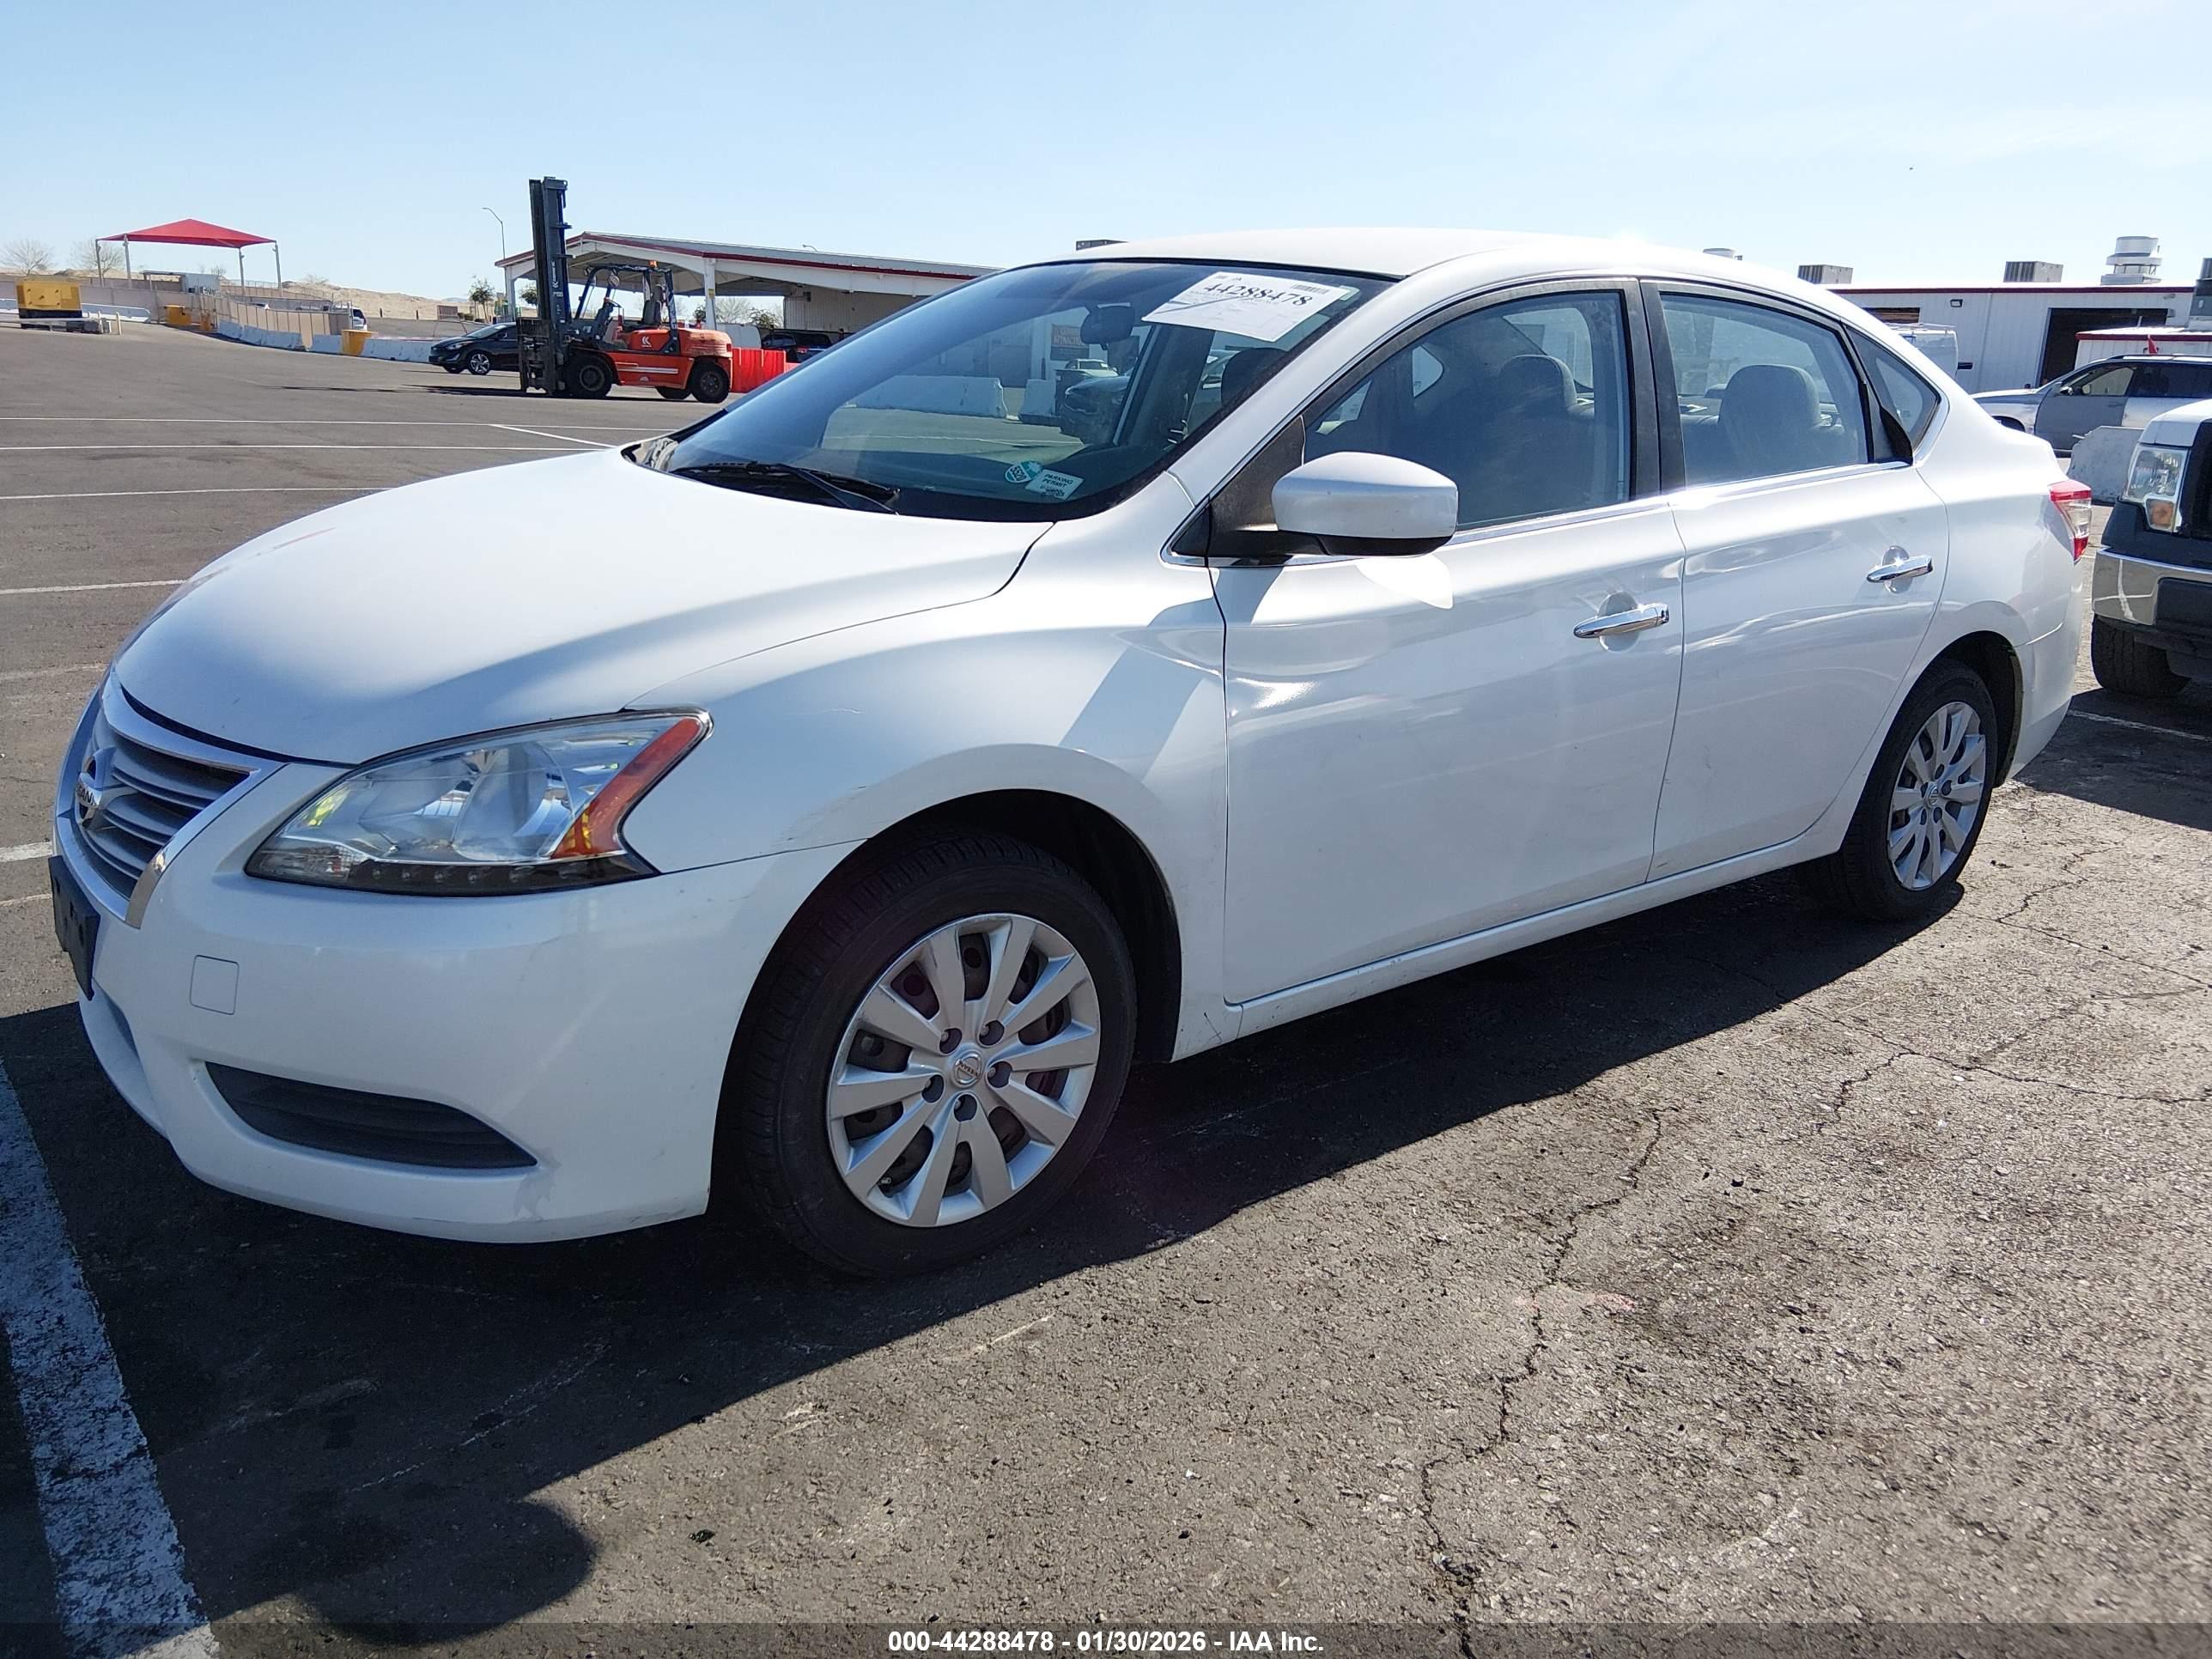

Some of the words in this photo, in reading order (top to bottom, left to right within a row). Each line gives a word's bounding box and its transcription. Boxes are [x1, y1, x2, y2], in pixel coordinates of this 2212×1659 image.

[1205, 283, 1313, 306] 44288478
[1042, 478, 1067, 488] PERMIT
[1044, 474, 1073, 485] PARKING
